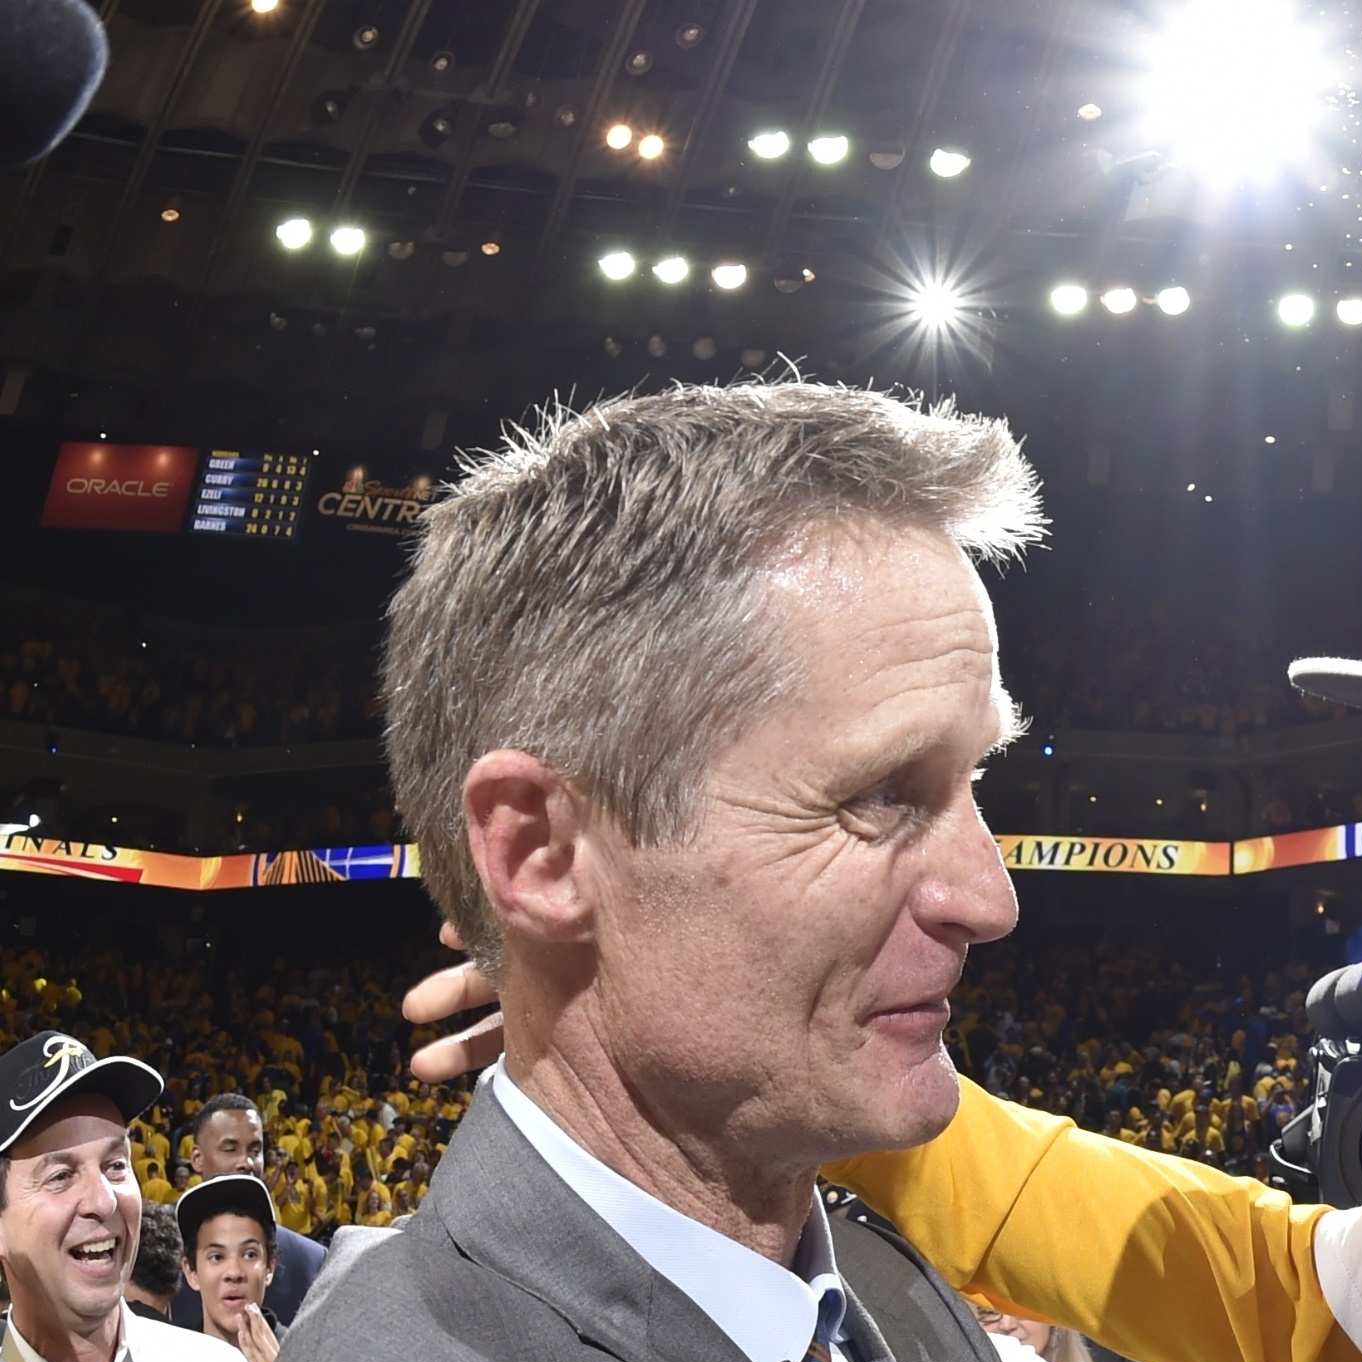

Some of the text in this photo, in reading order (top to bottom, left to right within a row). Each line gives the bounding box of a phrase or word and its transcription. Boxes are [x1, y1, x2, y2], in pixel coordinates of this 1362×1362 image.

[205, 474, 234, 485] CURRY
[66, 478, 170, 497] ORACLE
[197, 504, 246, 517] LIVINGSTON
